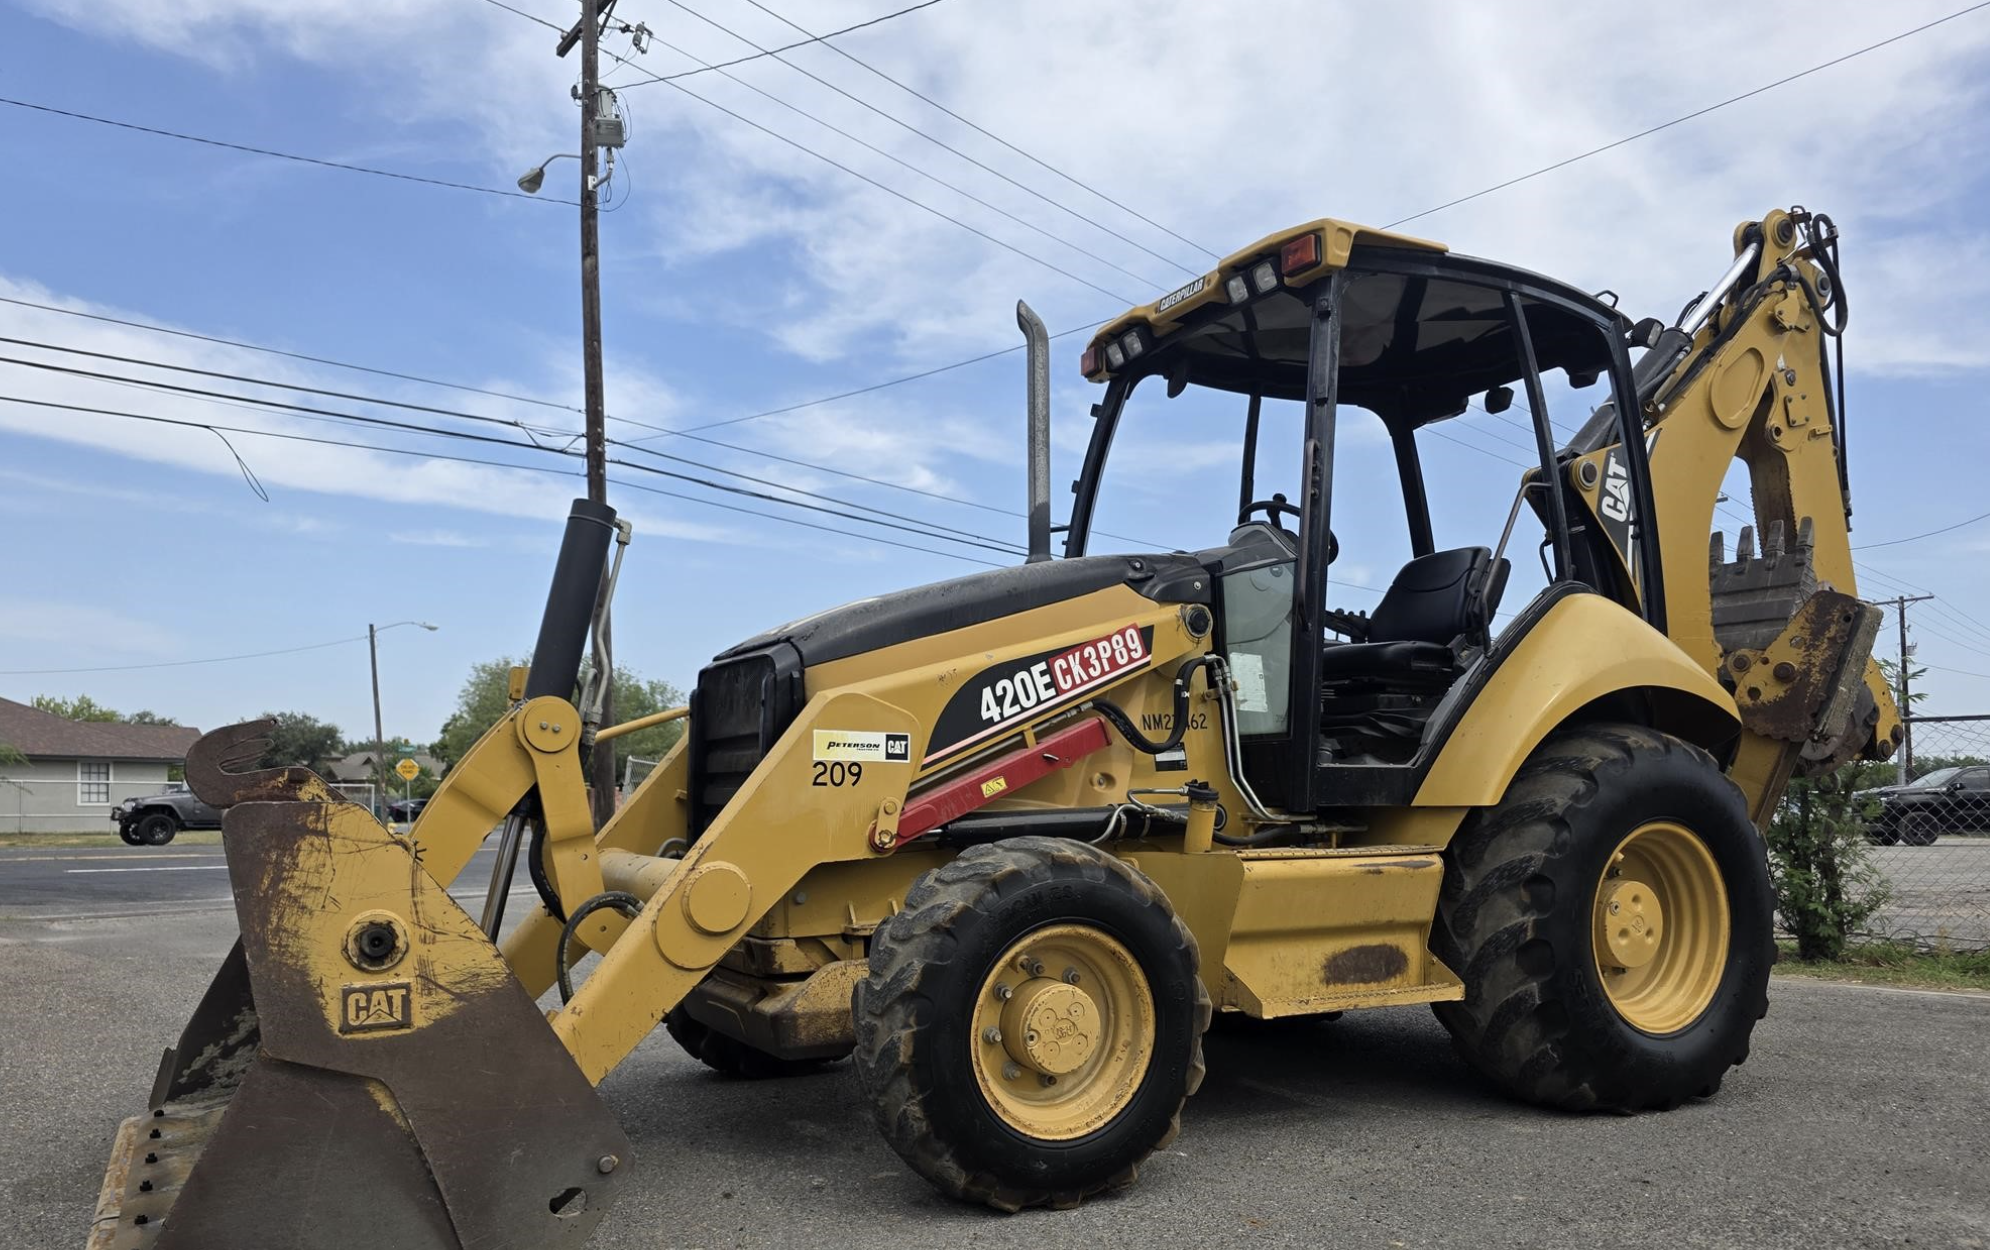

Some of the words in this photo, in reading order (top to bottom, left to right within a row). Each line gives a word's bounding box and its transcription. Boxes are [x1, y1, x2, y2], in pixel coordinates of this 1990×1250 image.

[1160, 279, 1204, 311] CATERPILLAR
[1601, 456, 1630, 522] CAT
[981, 661, 1056, 723] 420E
[1054, 628, 1143, 690] CK3P89
[1142, 713, 1207, 731] NM262
[827, 741, 880, 750] PETERSON
[887, 740, 907, 754] CAT
[812, 761, 862, 787] 209
[347, 988, 407, 1026] CAT
